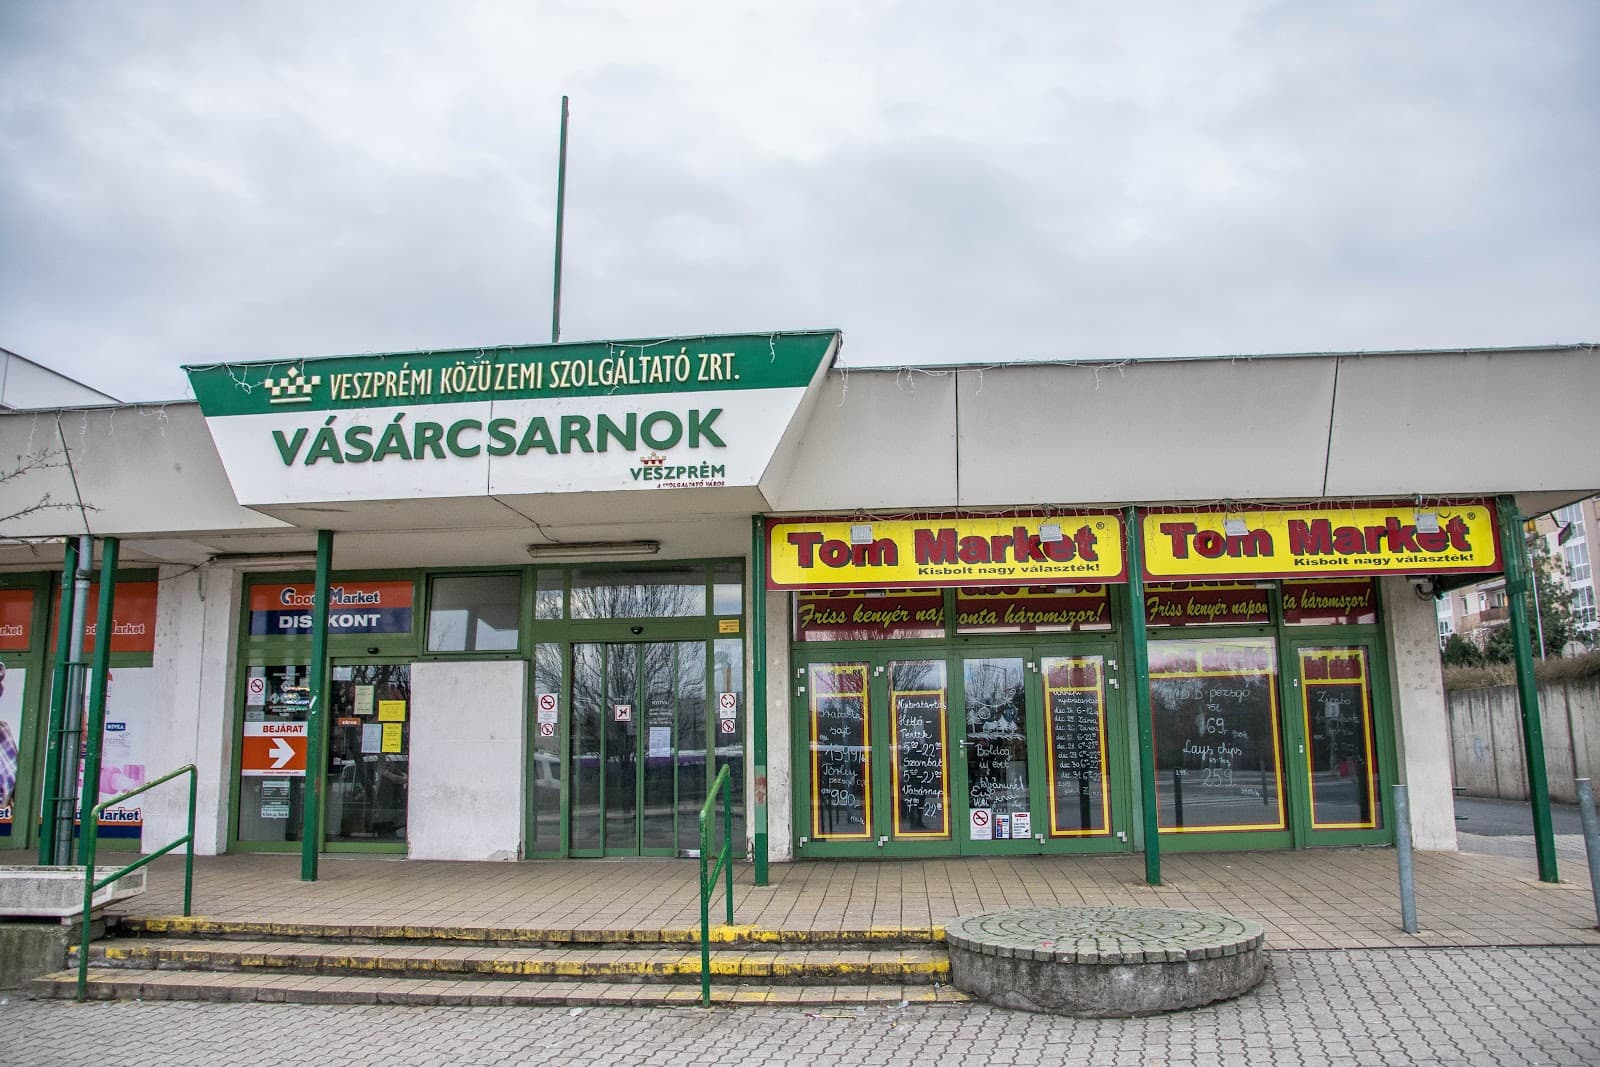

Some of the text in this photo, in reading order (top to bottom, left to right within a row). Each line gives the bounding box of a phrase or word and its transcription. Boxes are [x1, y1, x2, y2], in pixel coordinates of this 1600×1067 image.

[330, 347, 740, 400] VESZPRÉMI KÖZÜZEMI SZOLGÁLTATÓ ZRT.
[271, 408, 728, 465] VÁSÁRCSARNOK
[787, 525, 1099, 568] Tom Market
[1160, 515, 1472, 559] Tom Market
[918, 564, 1100, 576] Kisbolt nagy választék!
[1294, 554, 1474, 566] Kisbolt nagy választék!
[798, 603, 849, 628] Friss
[852, 603, 910, 628] kenyér
[1004, 602, 1105, 628] háromszor!
[1147, 596, 1183, 621] Friss
[1186, 596, 1228, 622] kenyér
[1301, 588, 1371, 615] háromszor!
[279, 614, 381, 629] DISKONT
[262, 725, 304, 733] BEJÁRAT
[976, 743, 1013, 761] Boldog
[1183, 740, 1242, 760] Lays chips
[903, 758, 943, 767] Szombat
